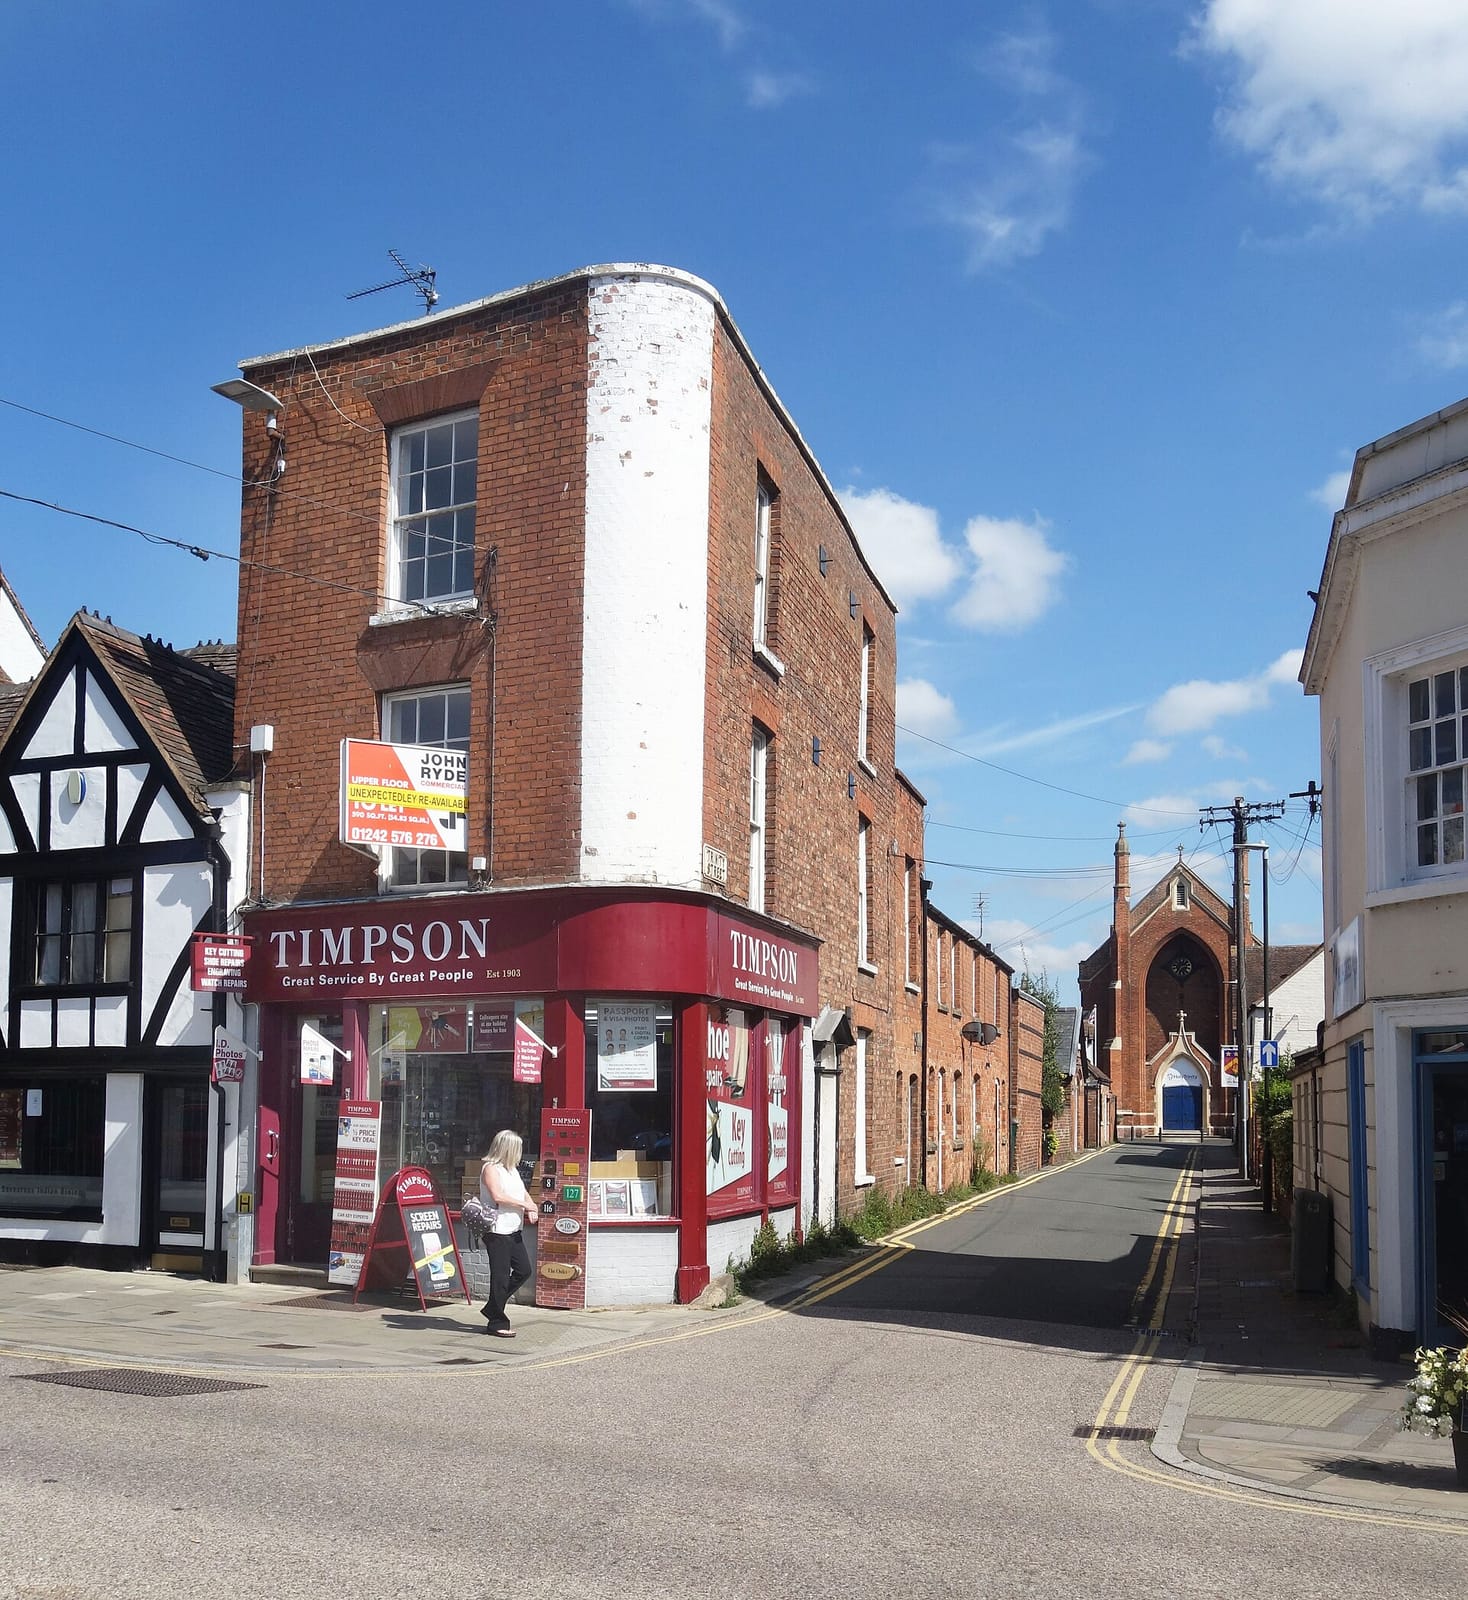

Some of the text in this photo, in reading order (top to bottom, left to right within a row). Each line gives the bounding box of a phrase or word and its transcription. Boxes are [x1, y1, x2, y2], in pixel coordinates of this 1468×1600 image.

[420, 753, 466, 769] JOHN
[352, 776, 409, 788] UPPER FLOOR
[420, 766, 466, 783] RYDE
[420, 780, 466, 790] COMMERCIAL
[350, 788, 417, 802] UNEXPECTEDLEY
[352, 827, 438, 846] 01242 576 276
[269, 918, 491, 968] TIMPSON
[204, 947, 244, 958] KEY CUTTING
[730, 929, 798, 985] TIMPSON
[204, 957, 245, 968] SHOE REPAIRS
[208, 967, 242, 976] ENGRAVING
[282, 968, 521, 986] Great Service By Great People Est 1903
[200, 978, 248, 988] WATCH REPAIRS
[734, 978, 748, 990] Great
[748, 980, 764, 994] Service
[764, 984, 770, 998] By
[770, 986, 781, 998] Great
[781, 990, 794, 1003] People
[604, 1007, 650, 1016] PASSPORT
[216, 1039, 230, 1048] I.D.
[707, 1014, 730, 1060] hoe
[216, 1048, 243, 1058] Photos
[706, 1065, 722, 1092] pairs
[732, 1112, 745, 1149] Key
[773, 1122, 786, 1141] Watch
[728, 1148, 745, 1168] Cutting
[774, 1144, 786, 1162] Repairs
[398, 1176, 434, 1194] TIMPSON
[546, 1179, 551, 1188] 8
[566, 1188, 579, 1198] 127
[240, 1195, 250, 1212] H
[544, 1204, 553, 1213] 116
[410, 1210, 439, 1222] SCREEN
[412, 1221, 442, 1232] REPAIRS
